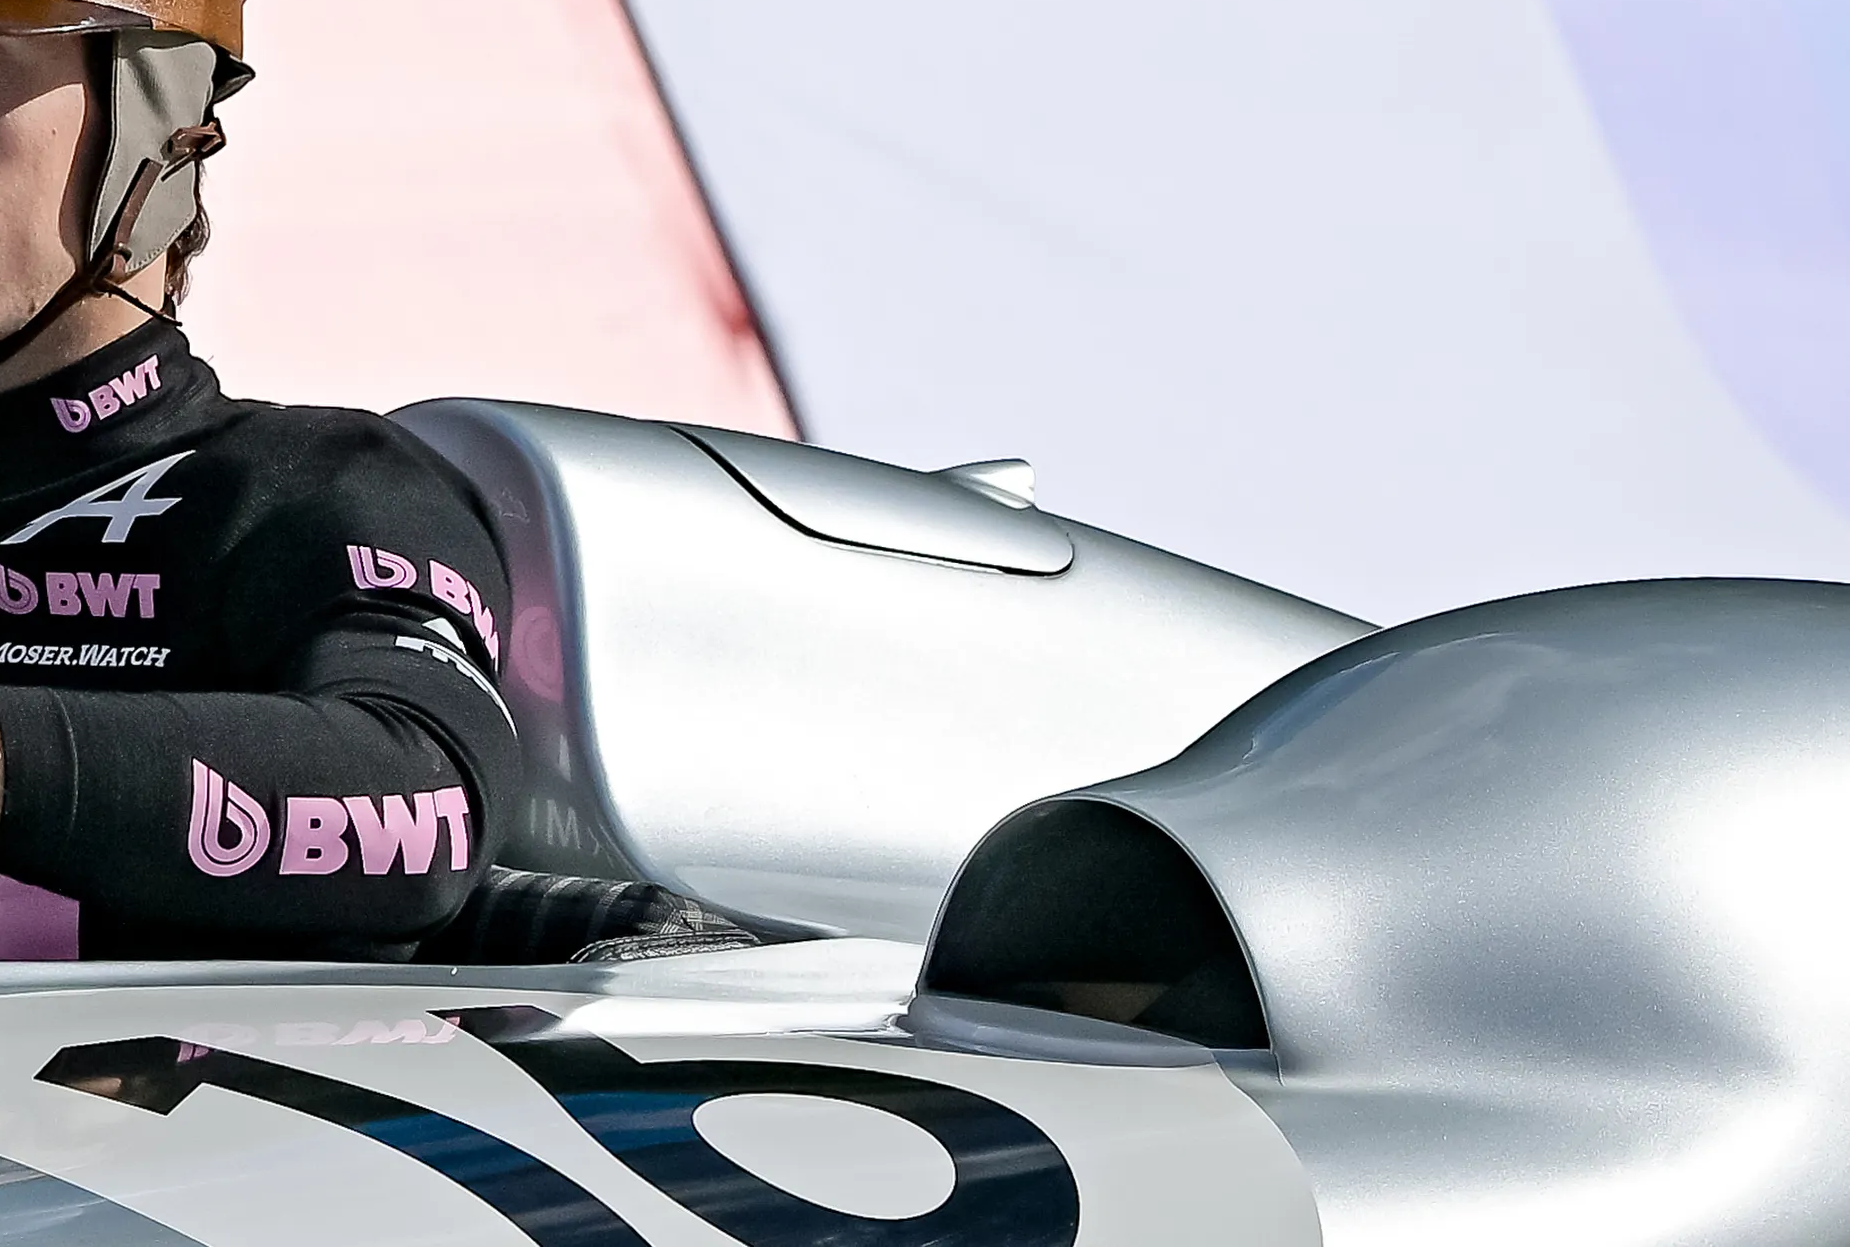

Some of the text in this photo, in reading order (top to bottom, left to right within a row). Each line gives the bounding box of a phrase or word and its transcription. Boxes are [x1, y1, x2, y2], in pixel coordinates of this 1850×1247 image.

[88, 354, 162, 420] BWT
[45, 572, 161, 619] BWT
[429, 559, 500, 674] BW
[278, 784, 470, 876] BWT
